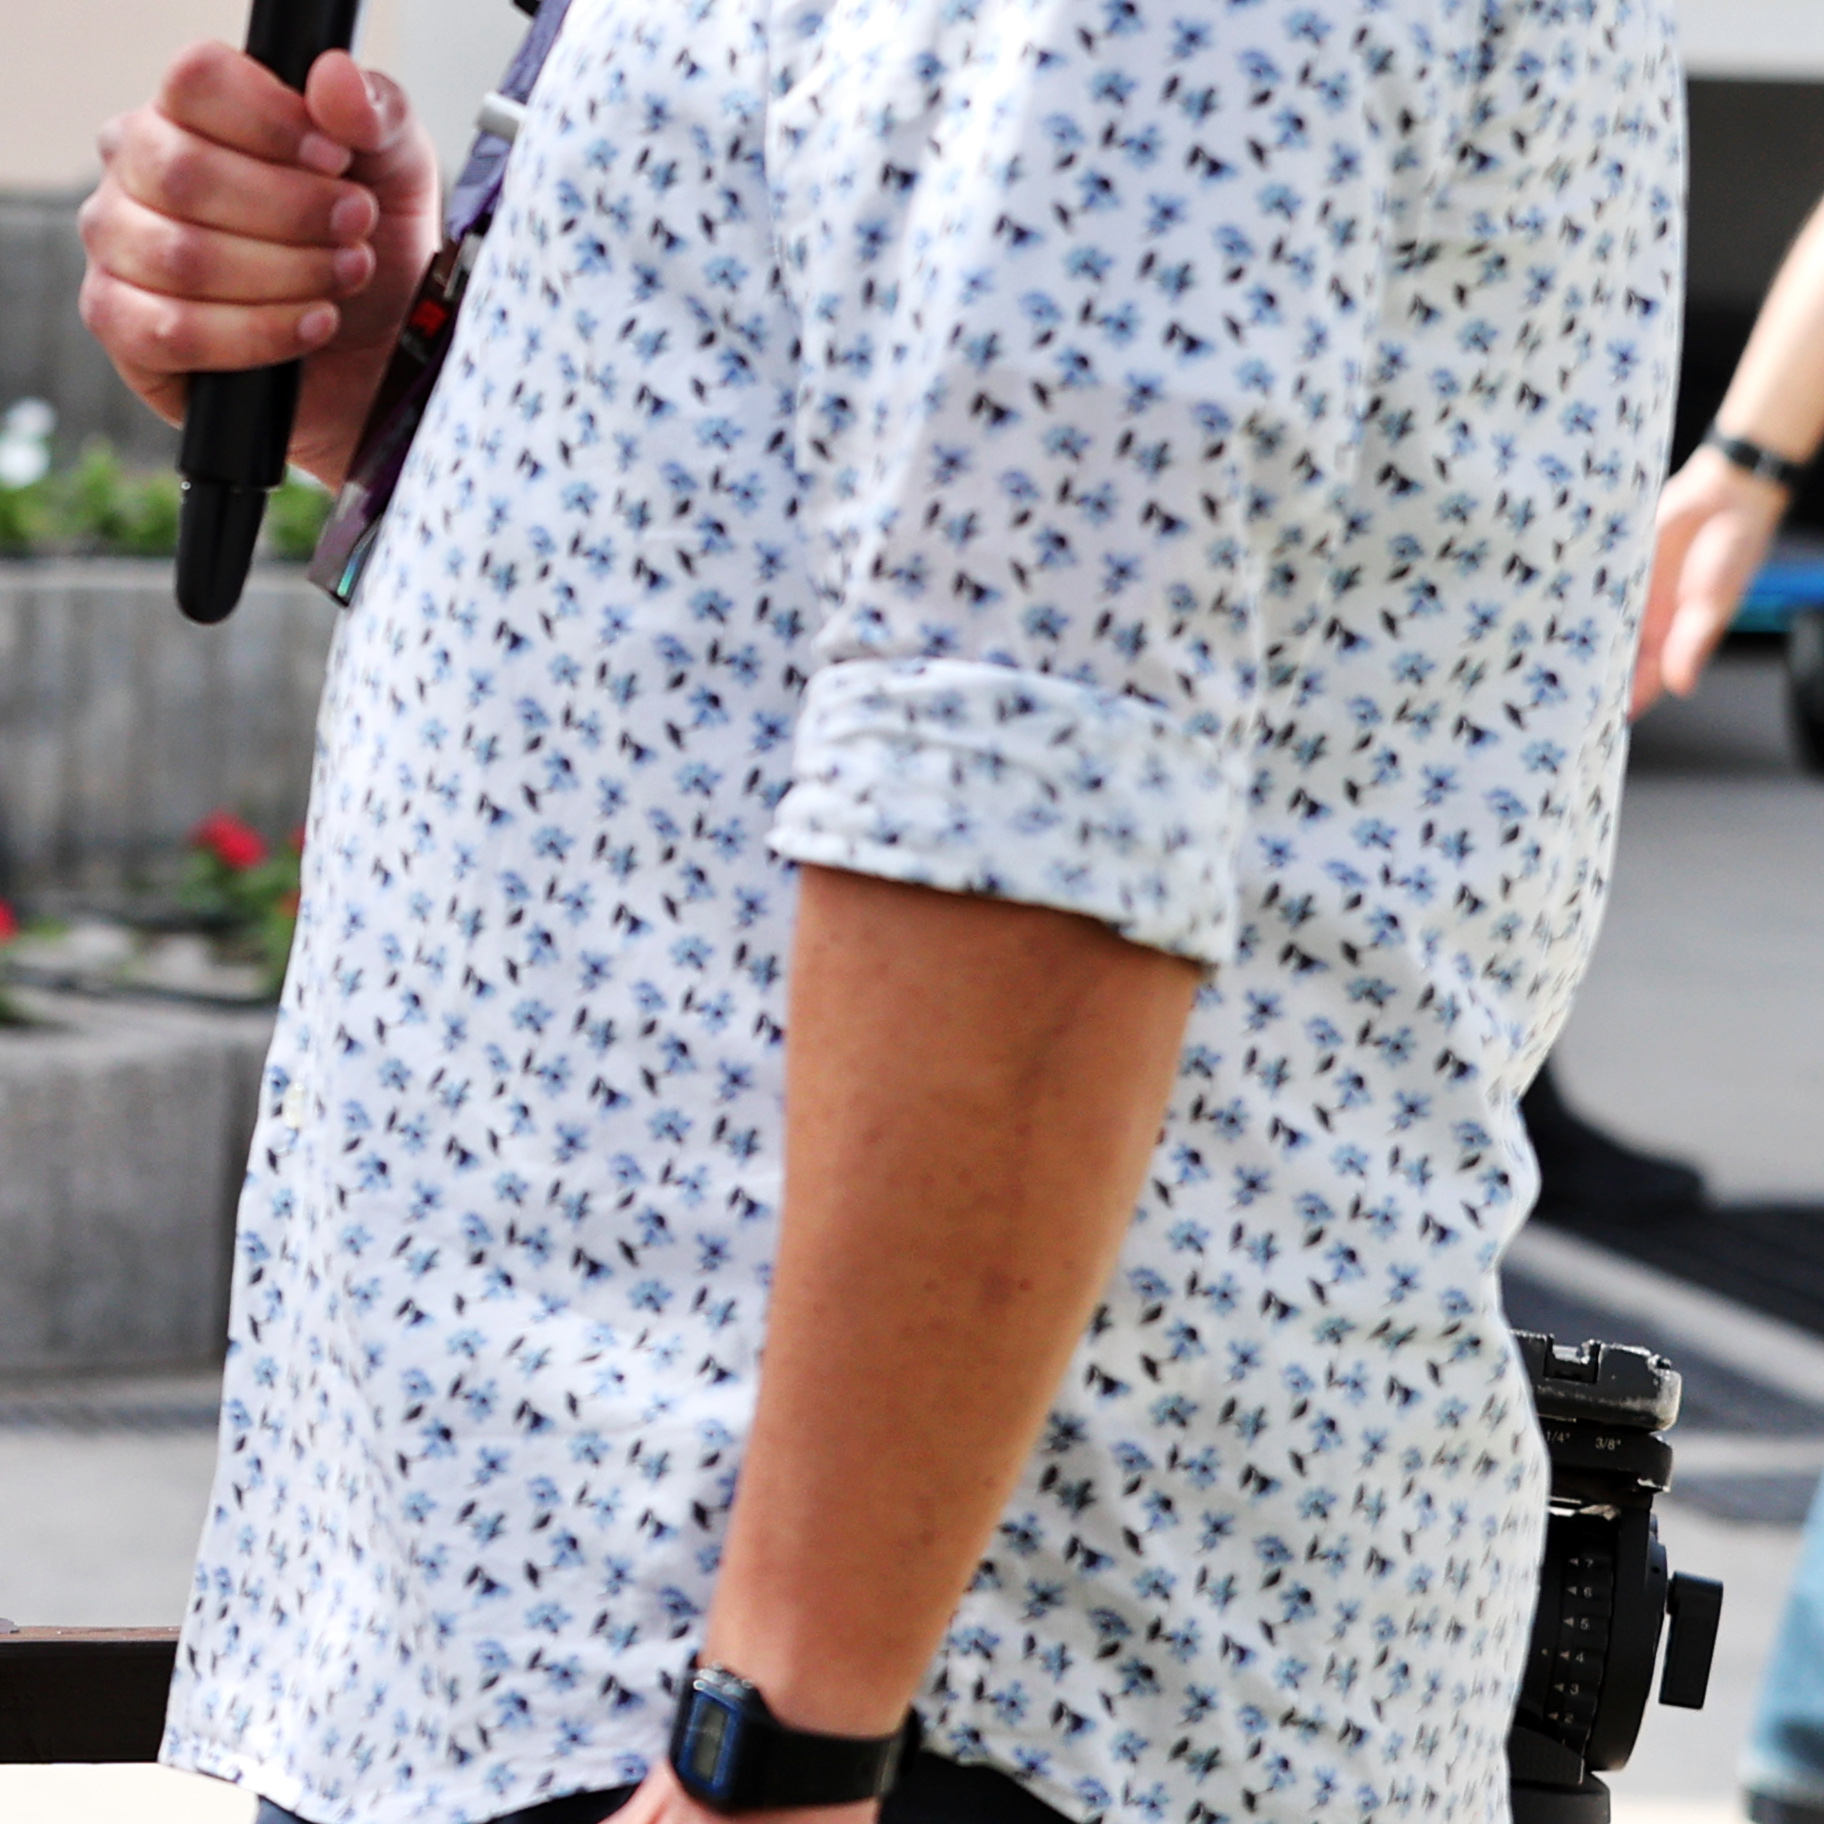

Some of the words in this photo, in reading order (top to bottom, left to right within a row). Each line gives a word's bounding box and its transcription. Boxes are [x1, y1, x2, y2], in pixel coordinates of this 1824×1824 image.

[1580, 1618, 1591, 1630] 5
[1575, 1652, 1585, 1664] 4
[1569, 1683, 1580, 1696] 3
